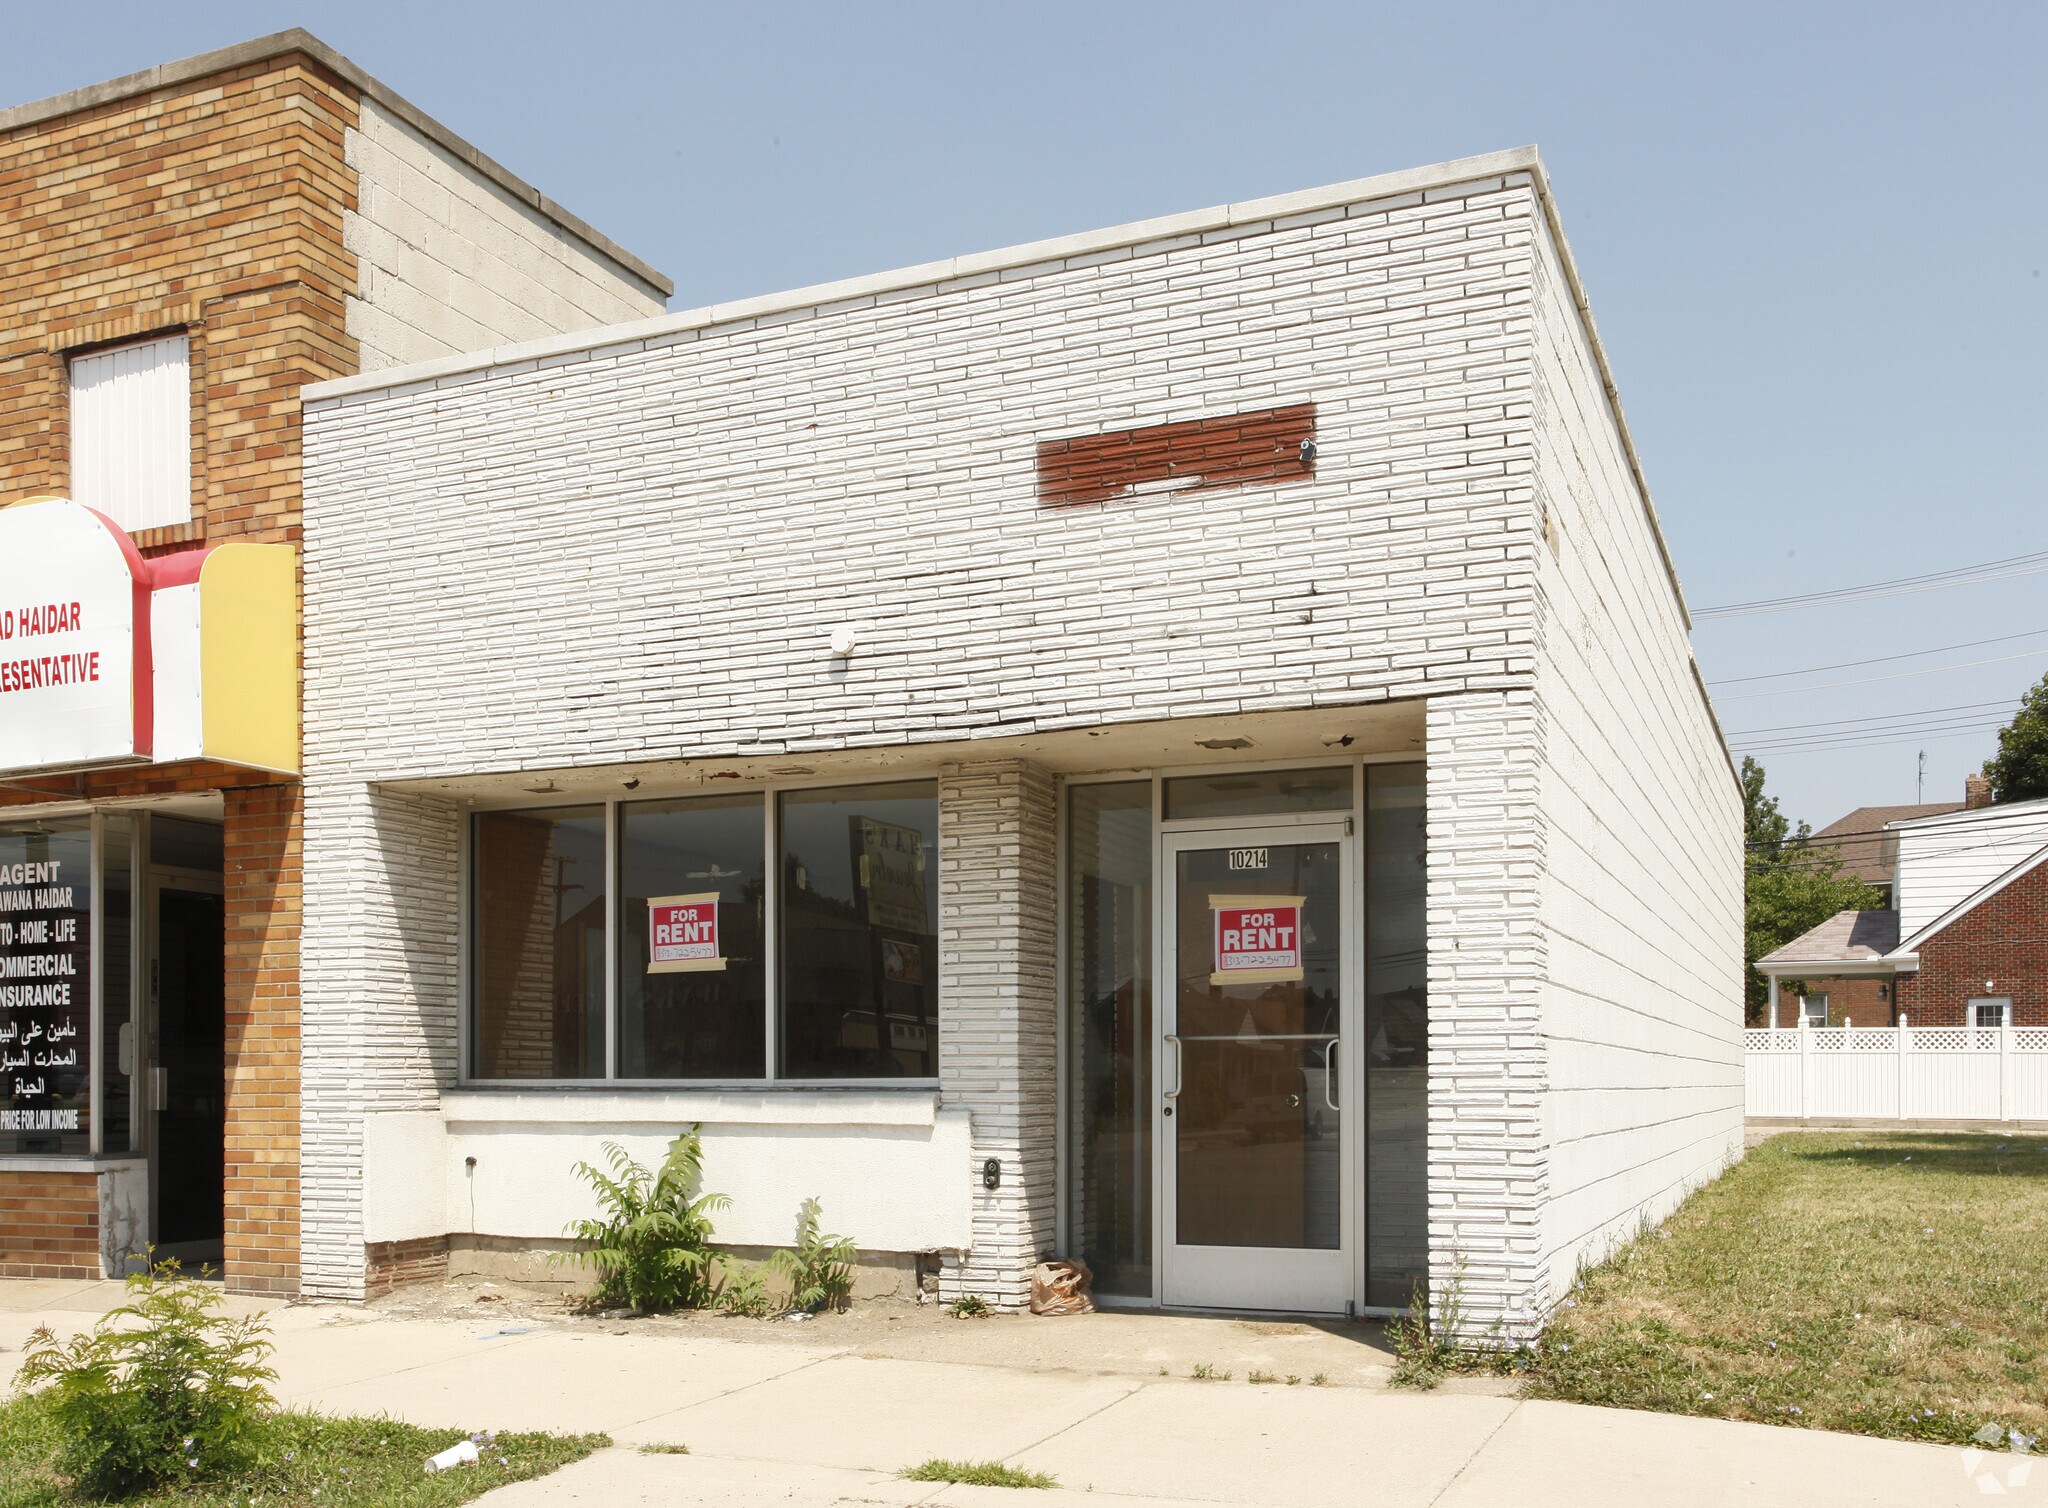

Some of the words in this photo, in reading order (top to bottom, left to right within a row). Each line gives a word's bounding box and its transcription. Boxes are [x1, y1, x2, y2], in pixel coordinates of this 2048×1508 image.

[19, 601, 81, 637] HAIDAR
[0, 651, 99, 693] ESENTATIVE
[1231, 849, 1267, 869] 10214
[0, 861, 61, 886] AGENT
[35, 886, 73, 910] HAIDAR
[670, 908, 698, 923] FOR
[1241, 912, 1275, 928] FOR
[0, 922, 13, 946] TO
[20, 920, 48, 944] HOME
[55, 918, 76, 943] LIFE
[656, 919, 712, 944] RENT
[1223, 926, 1294, 951] RENT
[0, 953, 76, 979] OMMERCIAL
[0, 983, 71, 1008] NSURANCE
[21, 1020, 43, 1046] على
[15, 1076, 45, 1099] الحياة
[0, 1109, 20, 1130] PRICE
[21, 1109, 35, 1130] FOR
[36, 1109, 51, 1130] LOW
[52, 1109, 79, 1130] INCOME
